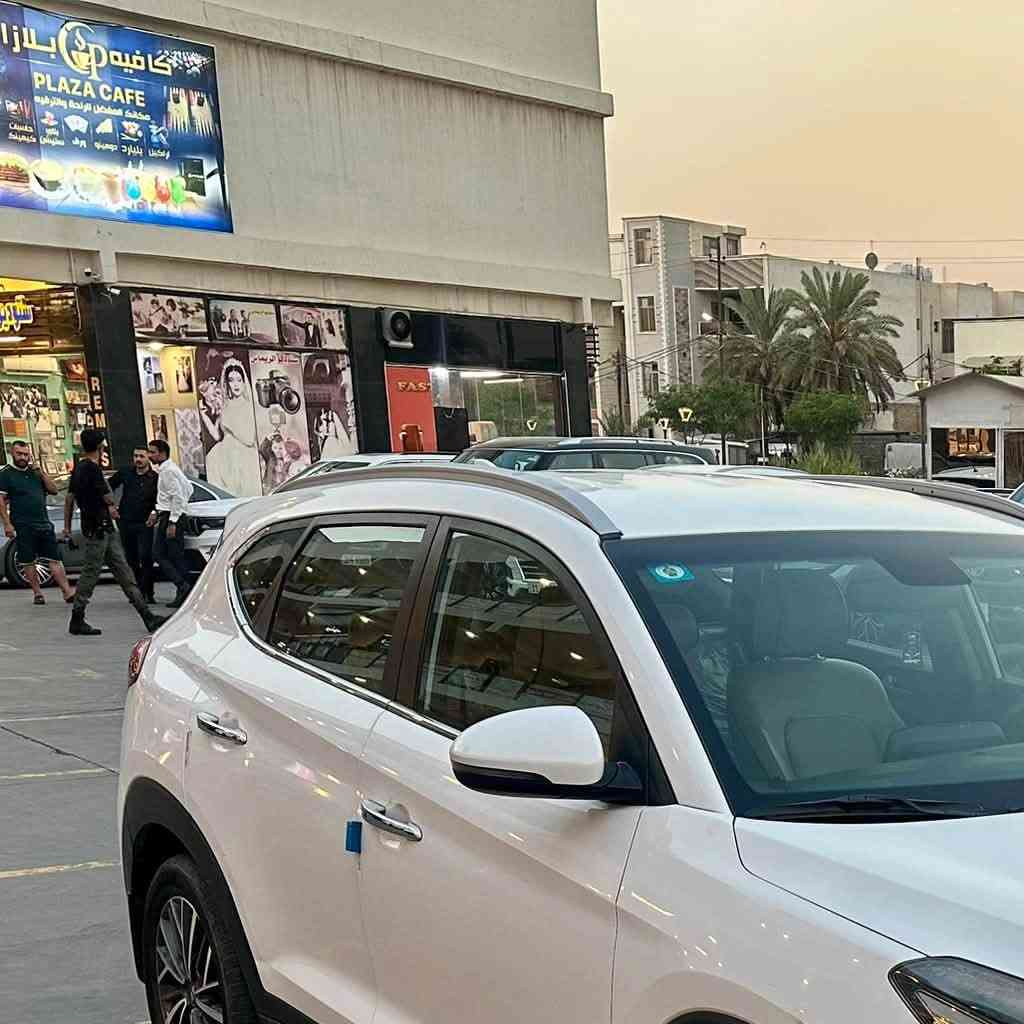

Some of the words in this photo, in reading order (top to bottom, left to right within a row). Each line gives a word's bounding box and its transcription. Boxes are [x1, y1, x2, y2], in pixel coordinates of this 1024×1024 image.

[1, 22, 57, 59] بلازا
[109, 49, 172, 76] كافيه
[33, 71, 96, 98] PLAZA
[99, 84, 145, 107] CAFE
